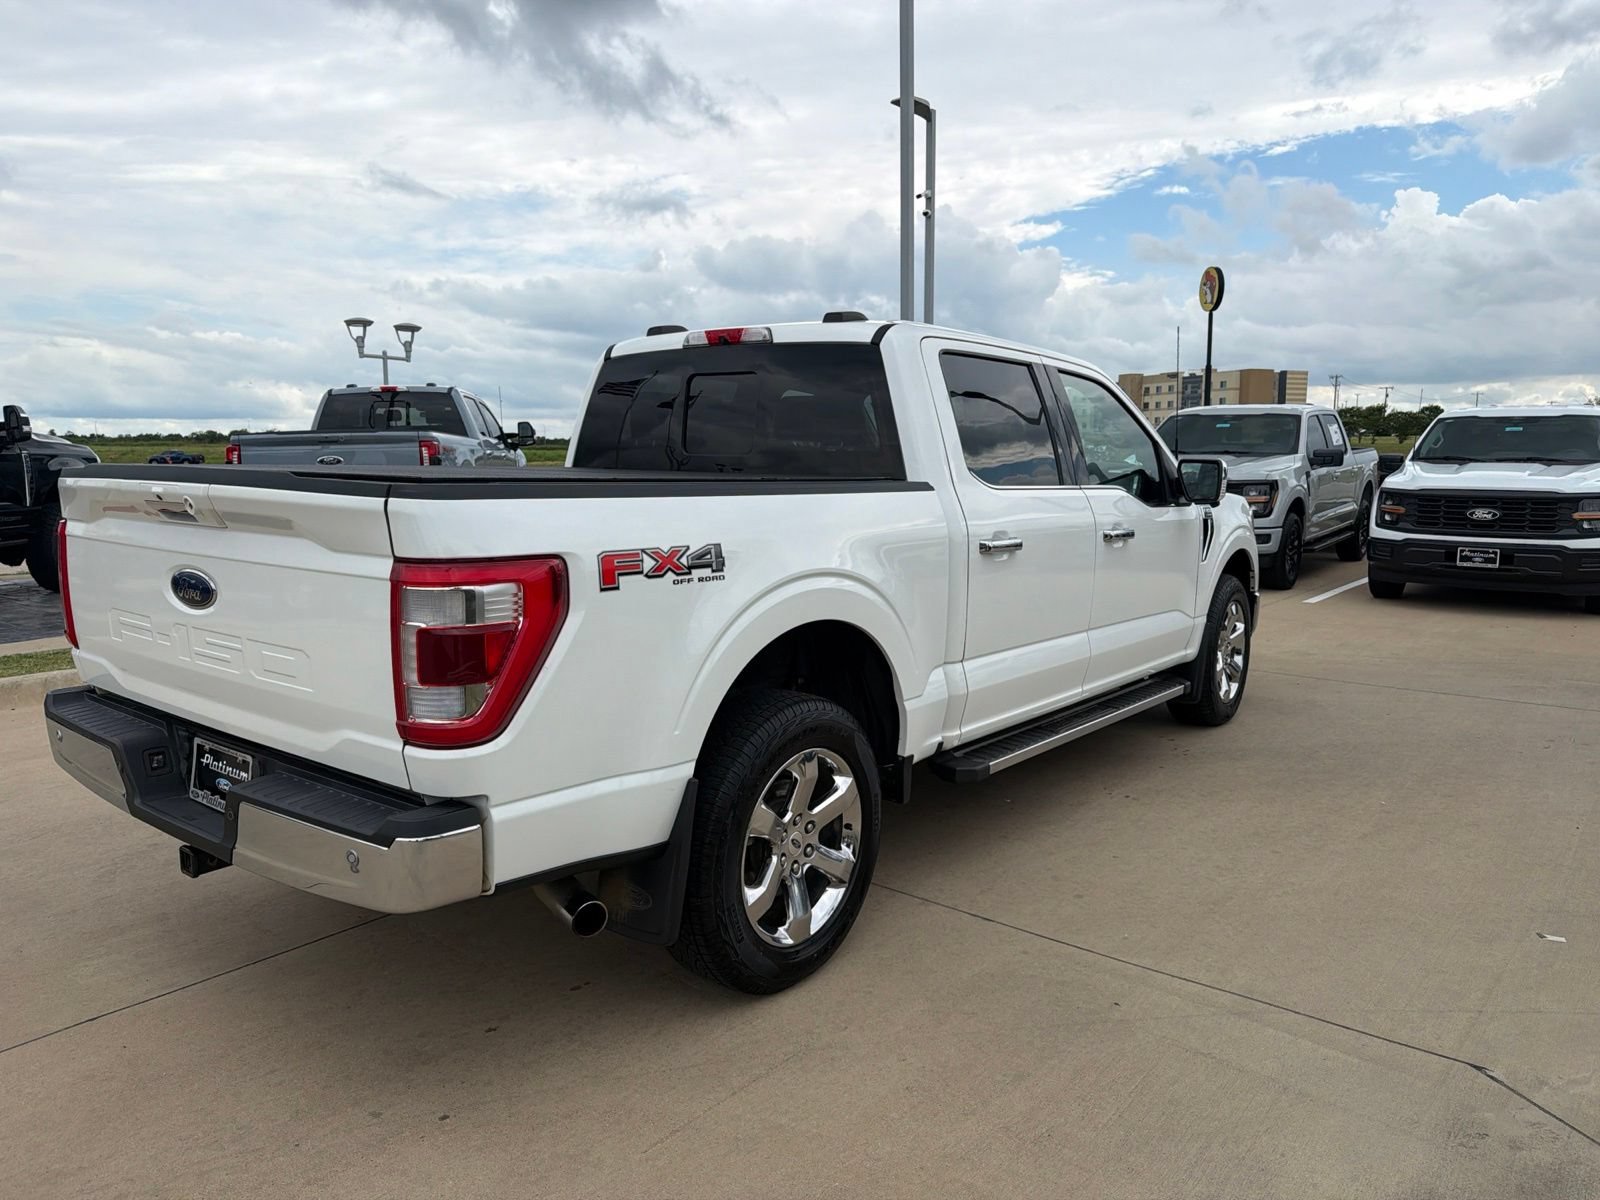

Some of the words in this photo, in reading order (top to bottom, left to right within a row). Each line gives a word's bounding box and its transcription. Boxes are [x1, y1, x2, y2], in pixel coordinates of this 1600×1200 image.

[597, 543, 726, 592] FX4
[672, 578, 694, 586] OFF
[697, 574, 726, 583] ROAD
[109, 607, 313, 692] F-150
[200, 753, 248, 782] Platinum
